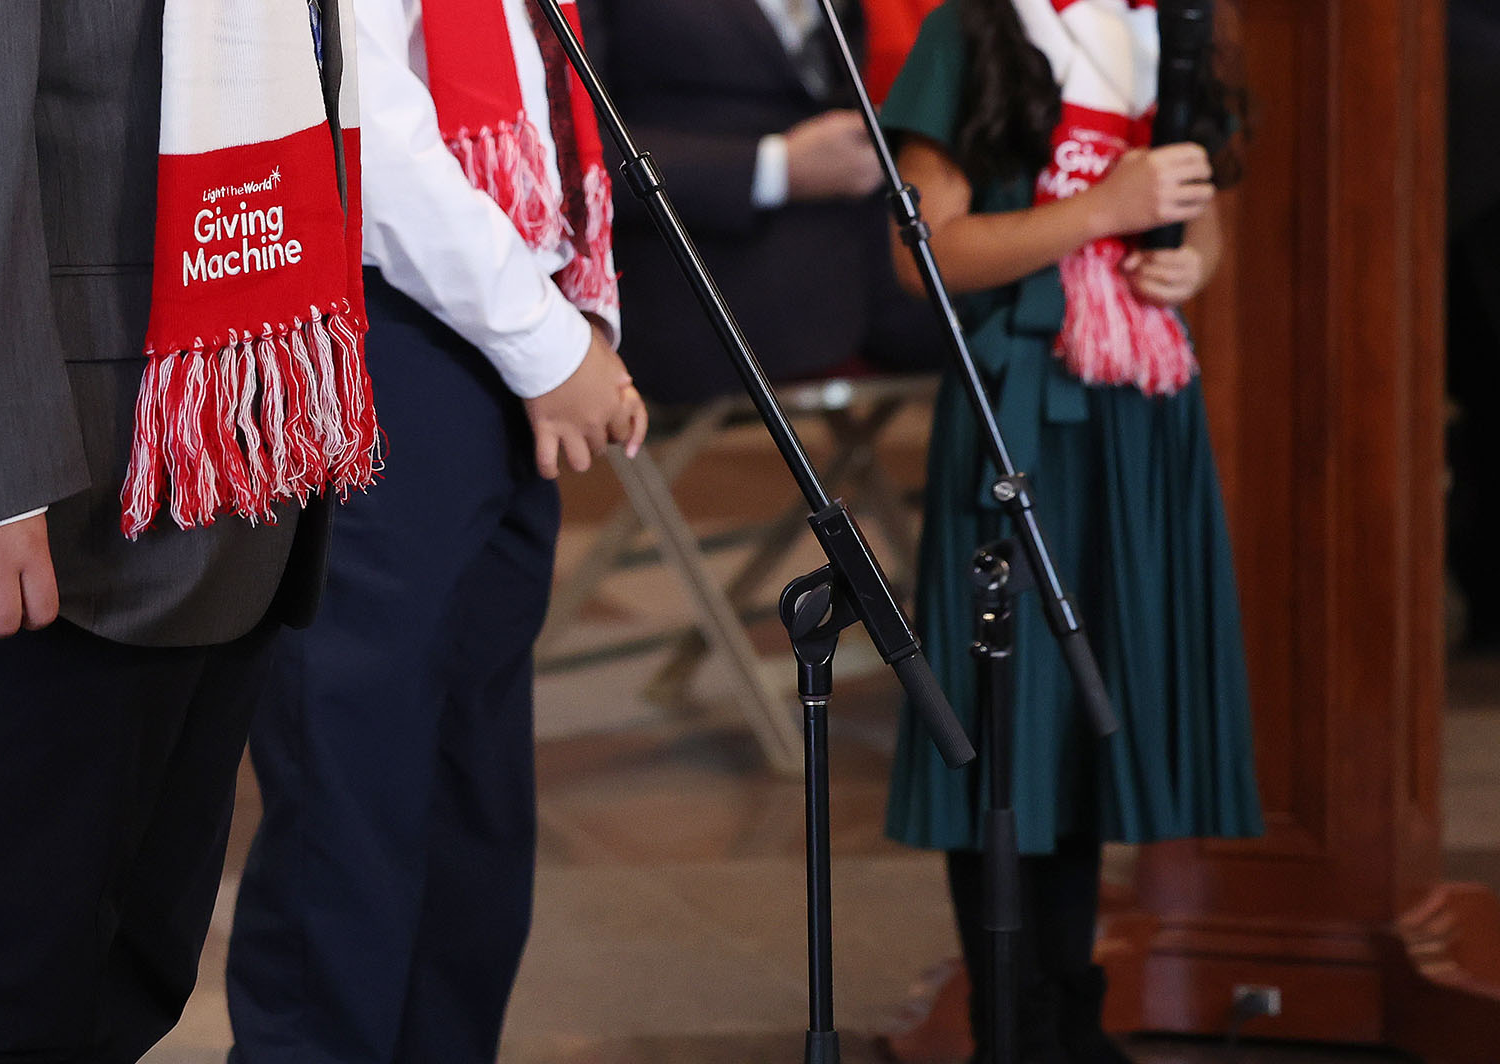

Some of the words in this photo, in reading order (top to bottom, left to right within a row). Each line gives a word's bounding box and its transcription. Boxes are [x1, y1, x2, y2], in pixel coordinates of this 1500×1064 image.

[1055, 140, 1111, 176] Giv
[194, 201, 284, 244] Giving
[182, 238, 303, 287] Machine
